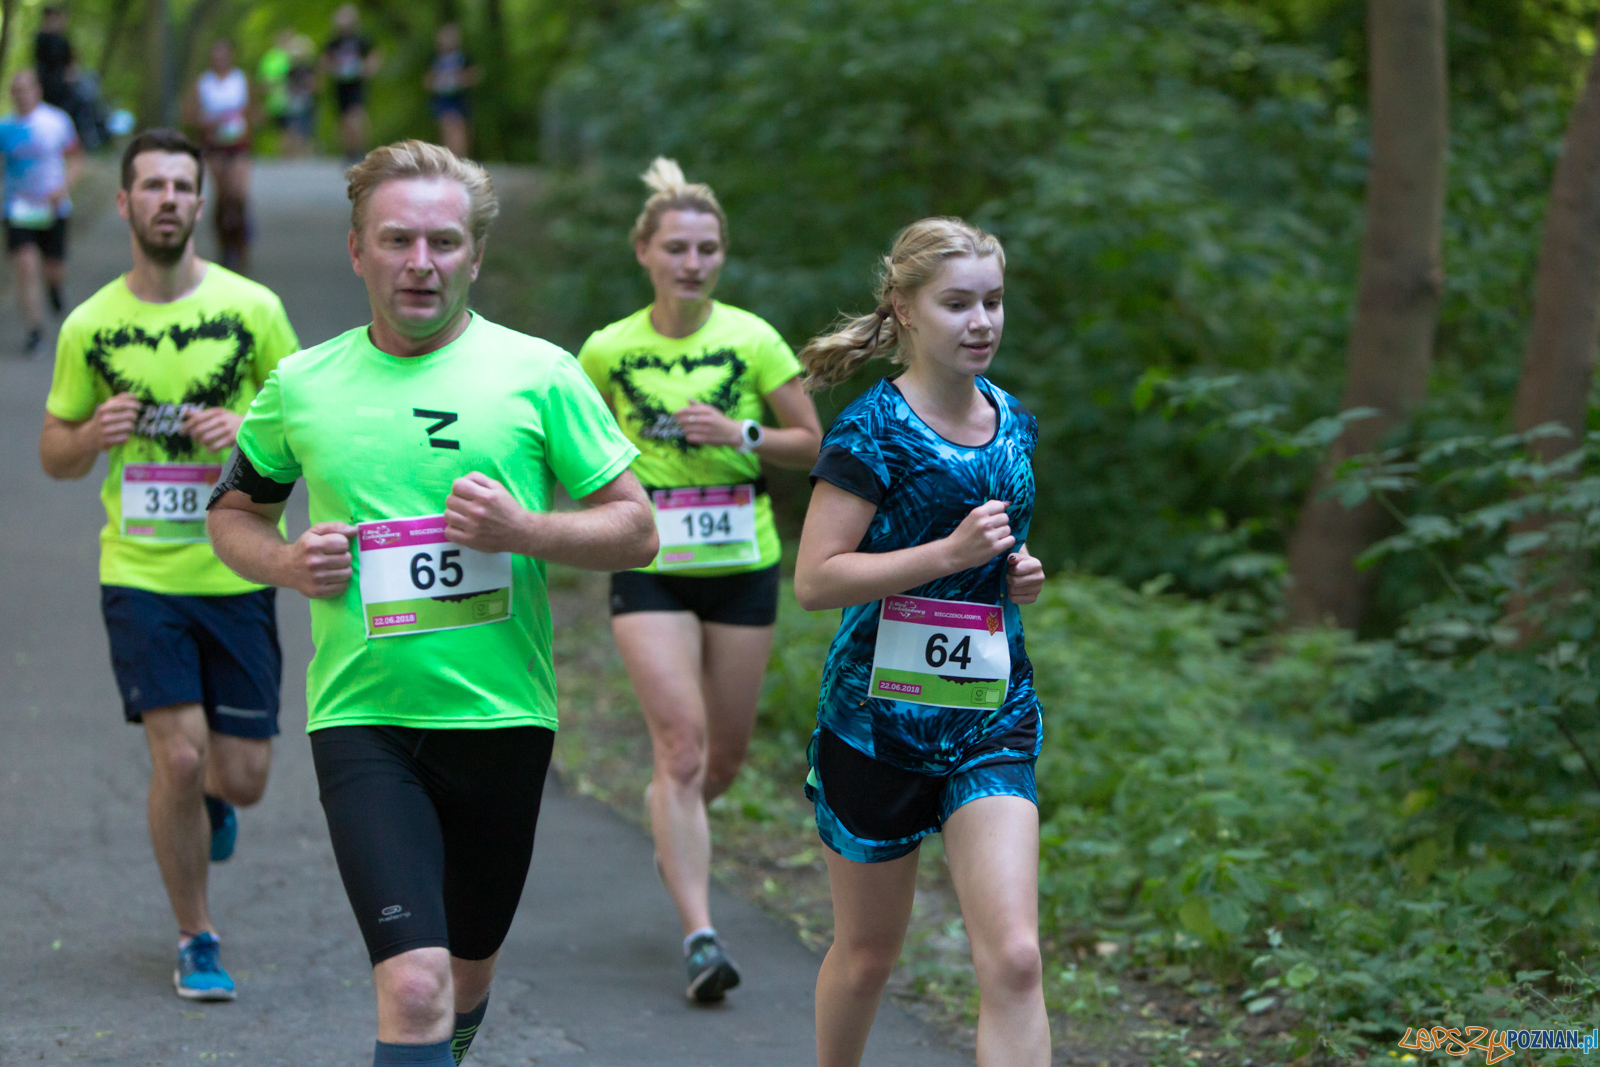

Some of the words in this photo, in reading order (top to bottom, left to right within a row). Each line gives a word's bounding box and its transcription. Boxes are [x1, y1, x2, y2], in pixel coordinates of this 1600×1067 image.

[146, 487, 197, 514] 338
[681, 510, 732, 538] 194
[410, 549, 463, 590] 65
[374, 614, 415, 626] 22.06.2018
[925, 633, 972, 670] 64
[880, 682, 920, 693] 22.06.2018
